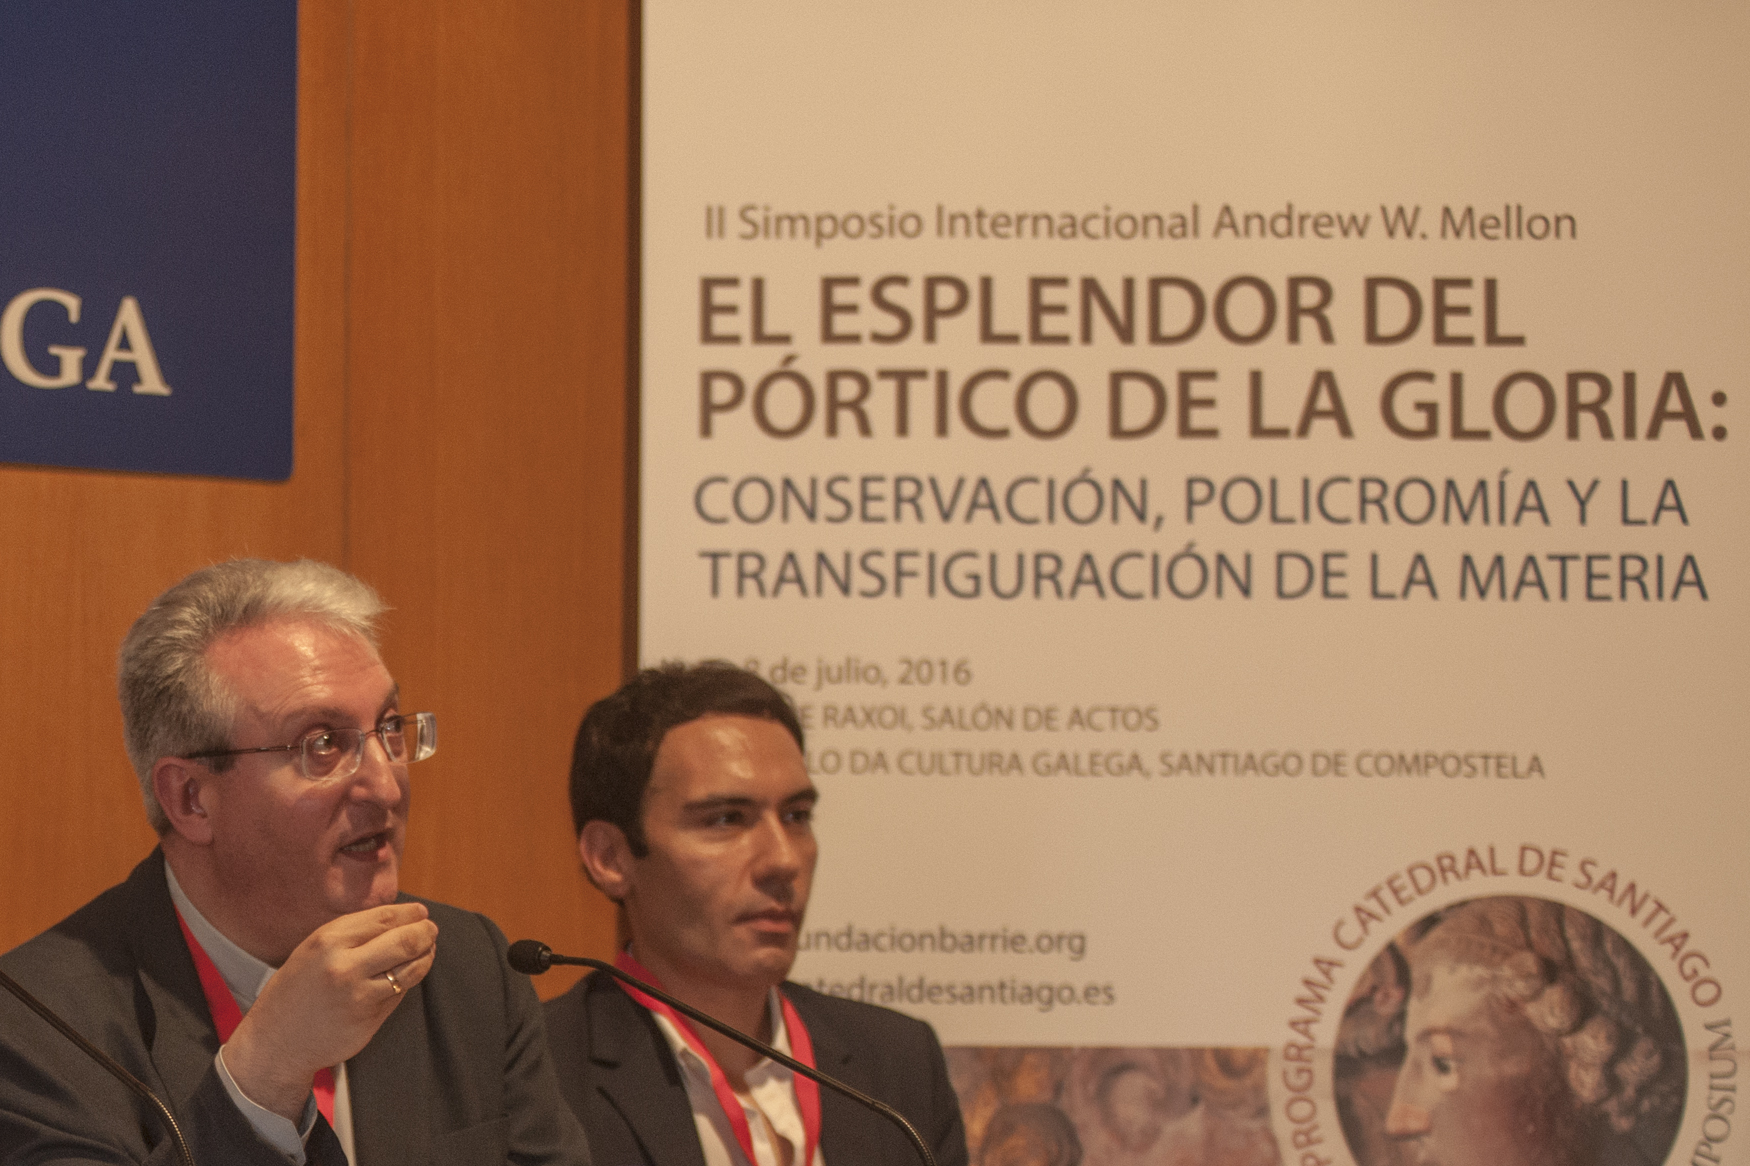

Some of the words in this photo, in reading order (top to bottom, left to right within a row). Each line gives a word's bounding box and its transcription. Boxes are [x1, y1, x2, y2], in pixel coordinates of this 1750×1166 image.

[704, 205, 725, 239] II
[738, 204, 923, 248] Simposio
[935, 203, 1200, 240] Internacional
[1212, 202, 1371, 240] Andrew
[1381, 204, 1429, 240] W.
[1440, 204, 1578, 241] Mellon
[699, 275, 793, 346] EL
[820, 274, 1336, 347] ESPLENDOR
[1364, 275, 1527, 347] DEL
[699, 353, 1080, 440] PÓRTICO
[1108, 369, 1220, 441] DE
[1248, 370, 1355, 441] LA
[1379, 370, 1730, 442] GLORIA:
[693, 467, 1165, 532] CONSERVACIÓN,
[1184, 468, 1551, 527] POLICROMÍA
[1565, 478, 1600, 526] Y
[1620, 478, 1690, 527] LA
[698, 541, 1252, 601] TRANSFIGURACIÓN
[1275, 551, 1350, 601] DE
[1370, 552, 1439, 601] LA
[1458, 553, 1710, 602] MATERIA
[769, 655, 808, 685] de
[813, 656, 888, 692] julio,
[897, 658, 973, 687] 2016
[921, 700, 1015, 732] SALÓN
[1023, 704, 1060, 732] DE
[1066, 704, 1161, 733] ACTOS
[850, 750, 890, 776] DA
[900, 750, 1024, 777] CULTURA
[1030, 751, 1151, 780] GALEGA,
[1159, 749, 1305, 778] SANTIAGO
[1311, 751, 1349, 778] DE
[1355, 751, 1546, 780] COMPOSTELA
[798, 923, 1088, 962] undacionbarrie.org
[1331, 842, 1509, 952] CATEDRAL
[1517, 842, 1569, 883] DE
[1572, 855, 1724, 1010] SANTIAGO
[815, 974, 1116, 1013] tedraldesantiago.es
